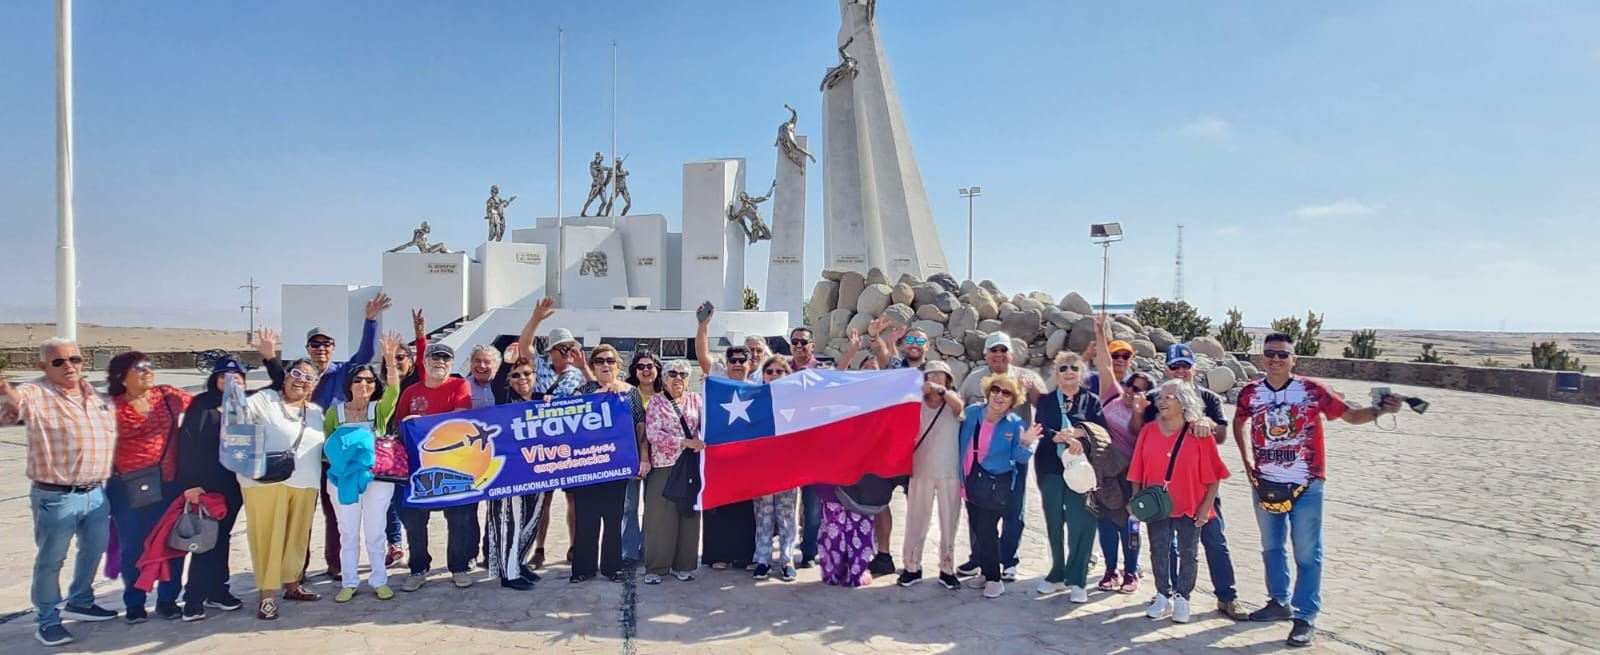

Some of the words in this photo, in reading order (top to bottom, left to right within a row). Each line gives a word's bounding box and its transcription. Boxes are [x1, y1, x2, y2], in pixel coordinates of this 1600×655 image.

[525, 401, 592, 420] Limarí
[511, 402, 613, 440] travel
[521, 444, 571, 463] Vive
[534, 454, 610, 473] experiencias
[488, 486, 512, 497] GIRAS
[513, 480, 559, 493] NACIONALES
[567, 467, 632, 484] INTERNACIONALES
